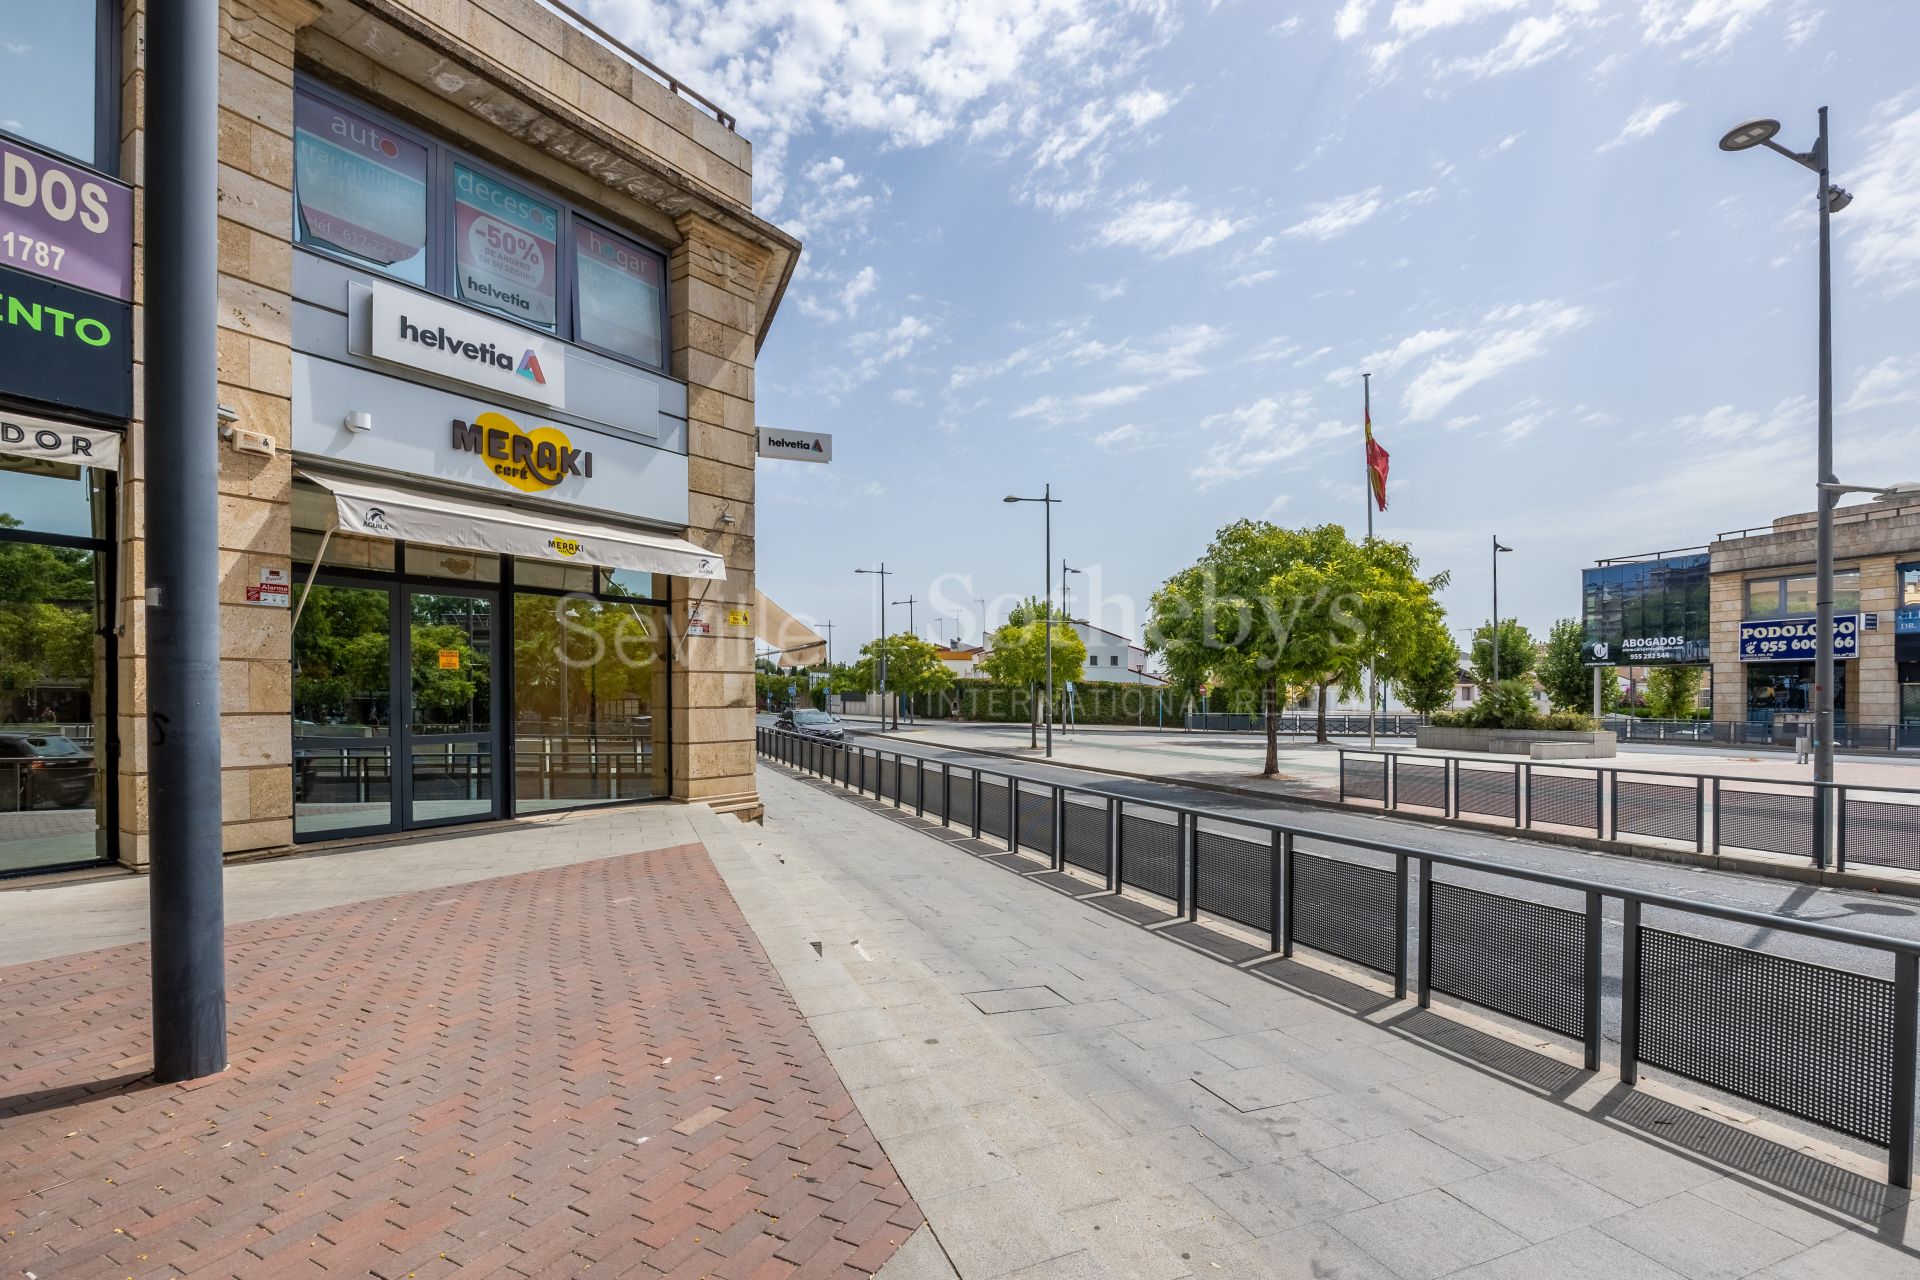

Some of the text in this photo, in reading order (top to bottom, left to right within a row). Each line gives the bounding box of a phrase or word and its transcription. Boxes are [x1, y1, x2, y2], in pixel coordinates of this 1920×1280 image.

[331, 116, 399, 159] auto
[4, 151, 110, 234] DOS
[457, 171, 555, 232] decesos
[3, 231, 66, 271] 1787
[475, 223, 540, 265] -50%
[484, 246, 531, 272] DE AHORRO
[589, 230, 648, 271] hogar
[467, 275, 531, 311] helvetia
[0, 293, 111, 347] NTO
[399, 314, 514, 371] helvetia
[1, 421, 93, 457] DOR
[452, 419, 593, 486] MERAKI
[768, 436, 810, 450] helvetia
[494, 463, 529, 480] CAFÉ
[547, 540, 584, 555] MERAKI
[261, 584, 288, 592] Alarma
[1621, 635, 1684, 648] ABOGADOS
[1760, 640, 1788, 653] 955
